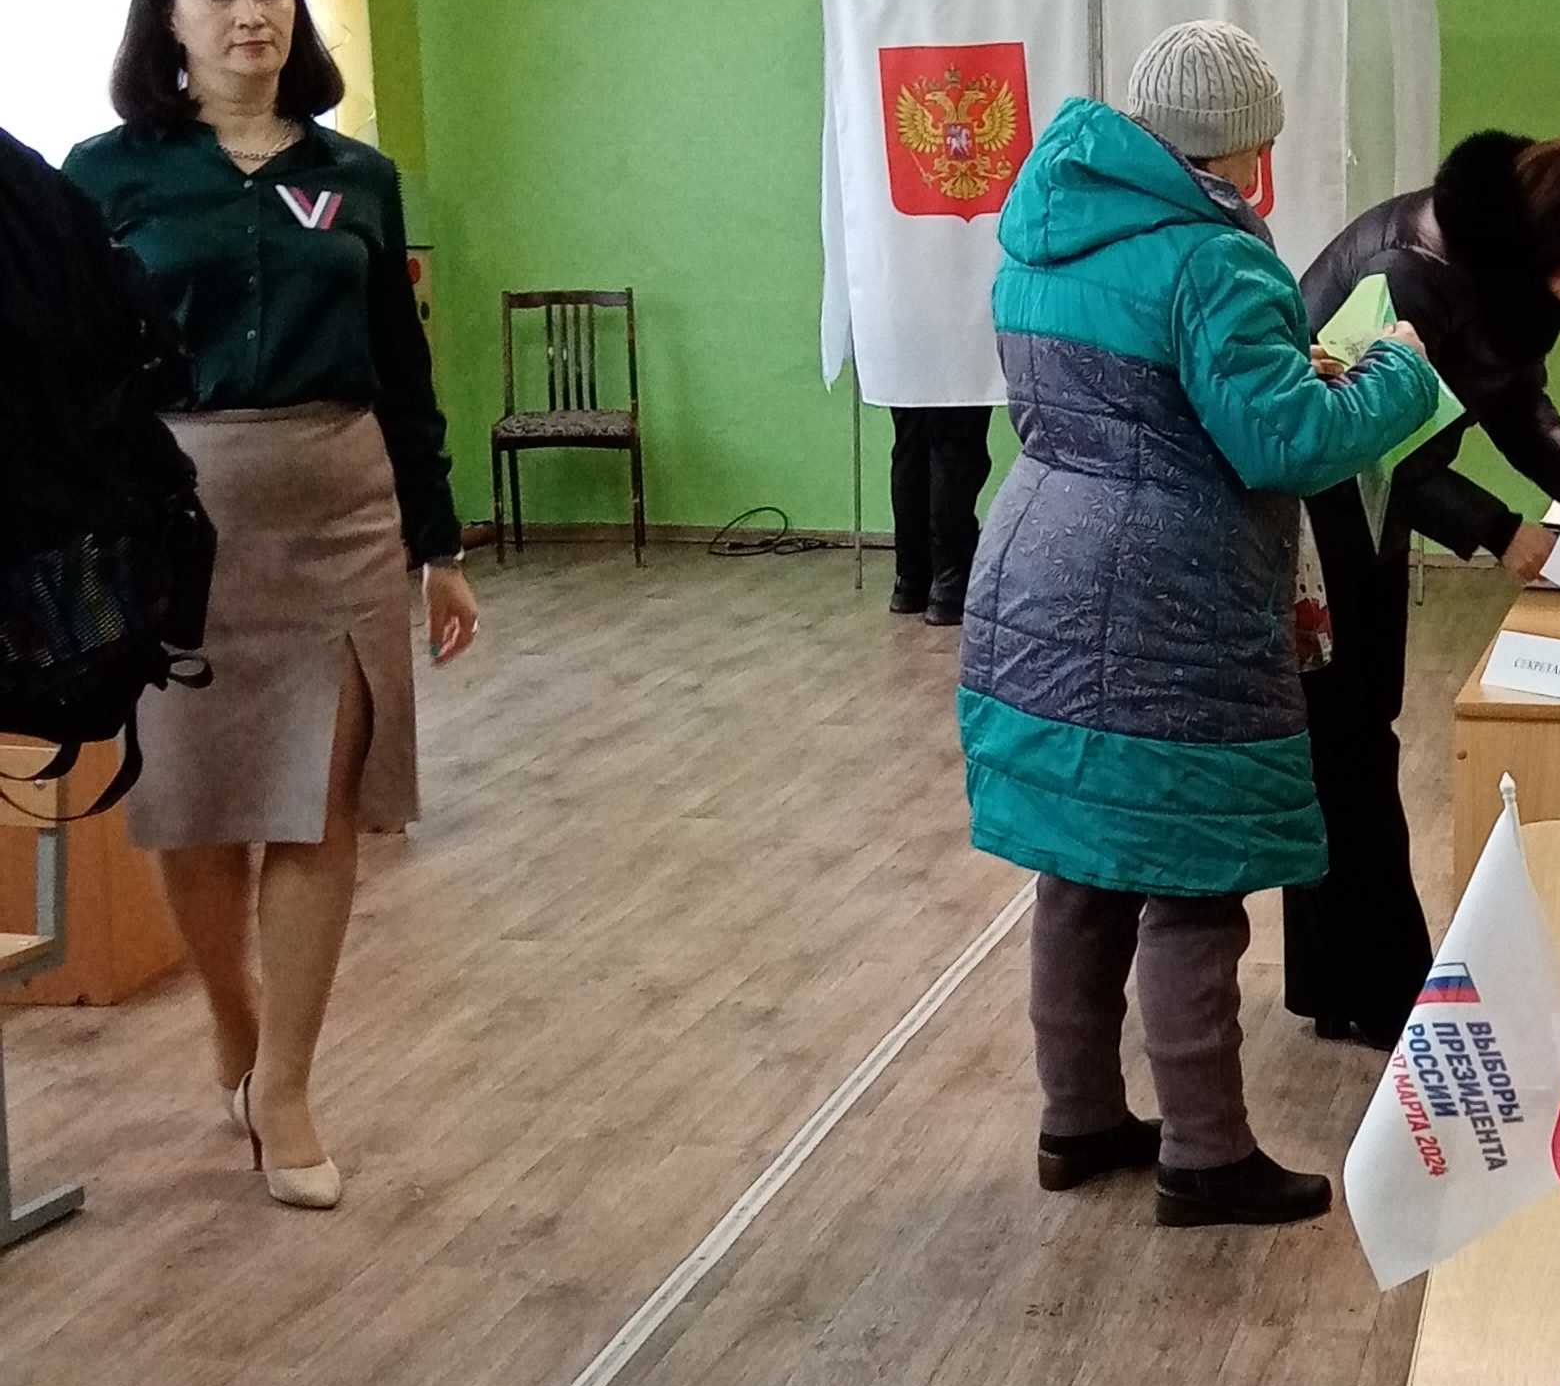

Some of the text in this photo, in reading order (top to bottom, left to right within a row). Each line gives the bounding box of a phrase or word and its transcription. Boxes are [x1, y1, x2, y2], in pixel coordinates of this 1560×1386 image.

[1407, 1023, 1459, 1117] РОССИИ
[1432, 1022, 1508, 1171] ПРЕЗИДЕНТА
[1466, 1021, 1524, 1124] ВЫБОРЫ
[1393, 1074, 1431, 1132] МАРТА
[1415, 1135, 1449, 1177] 2024
